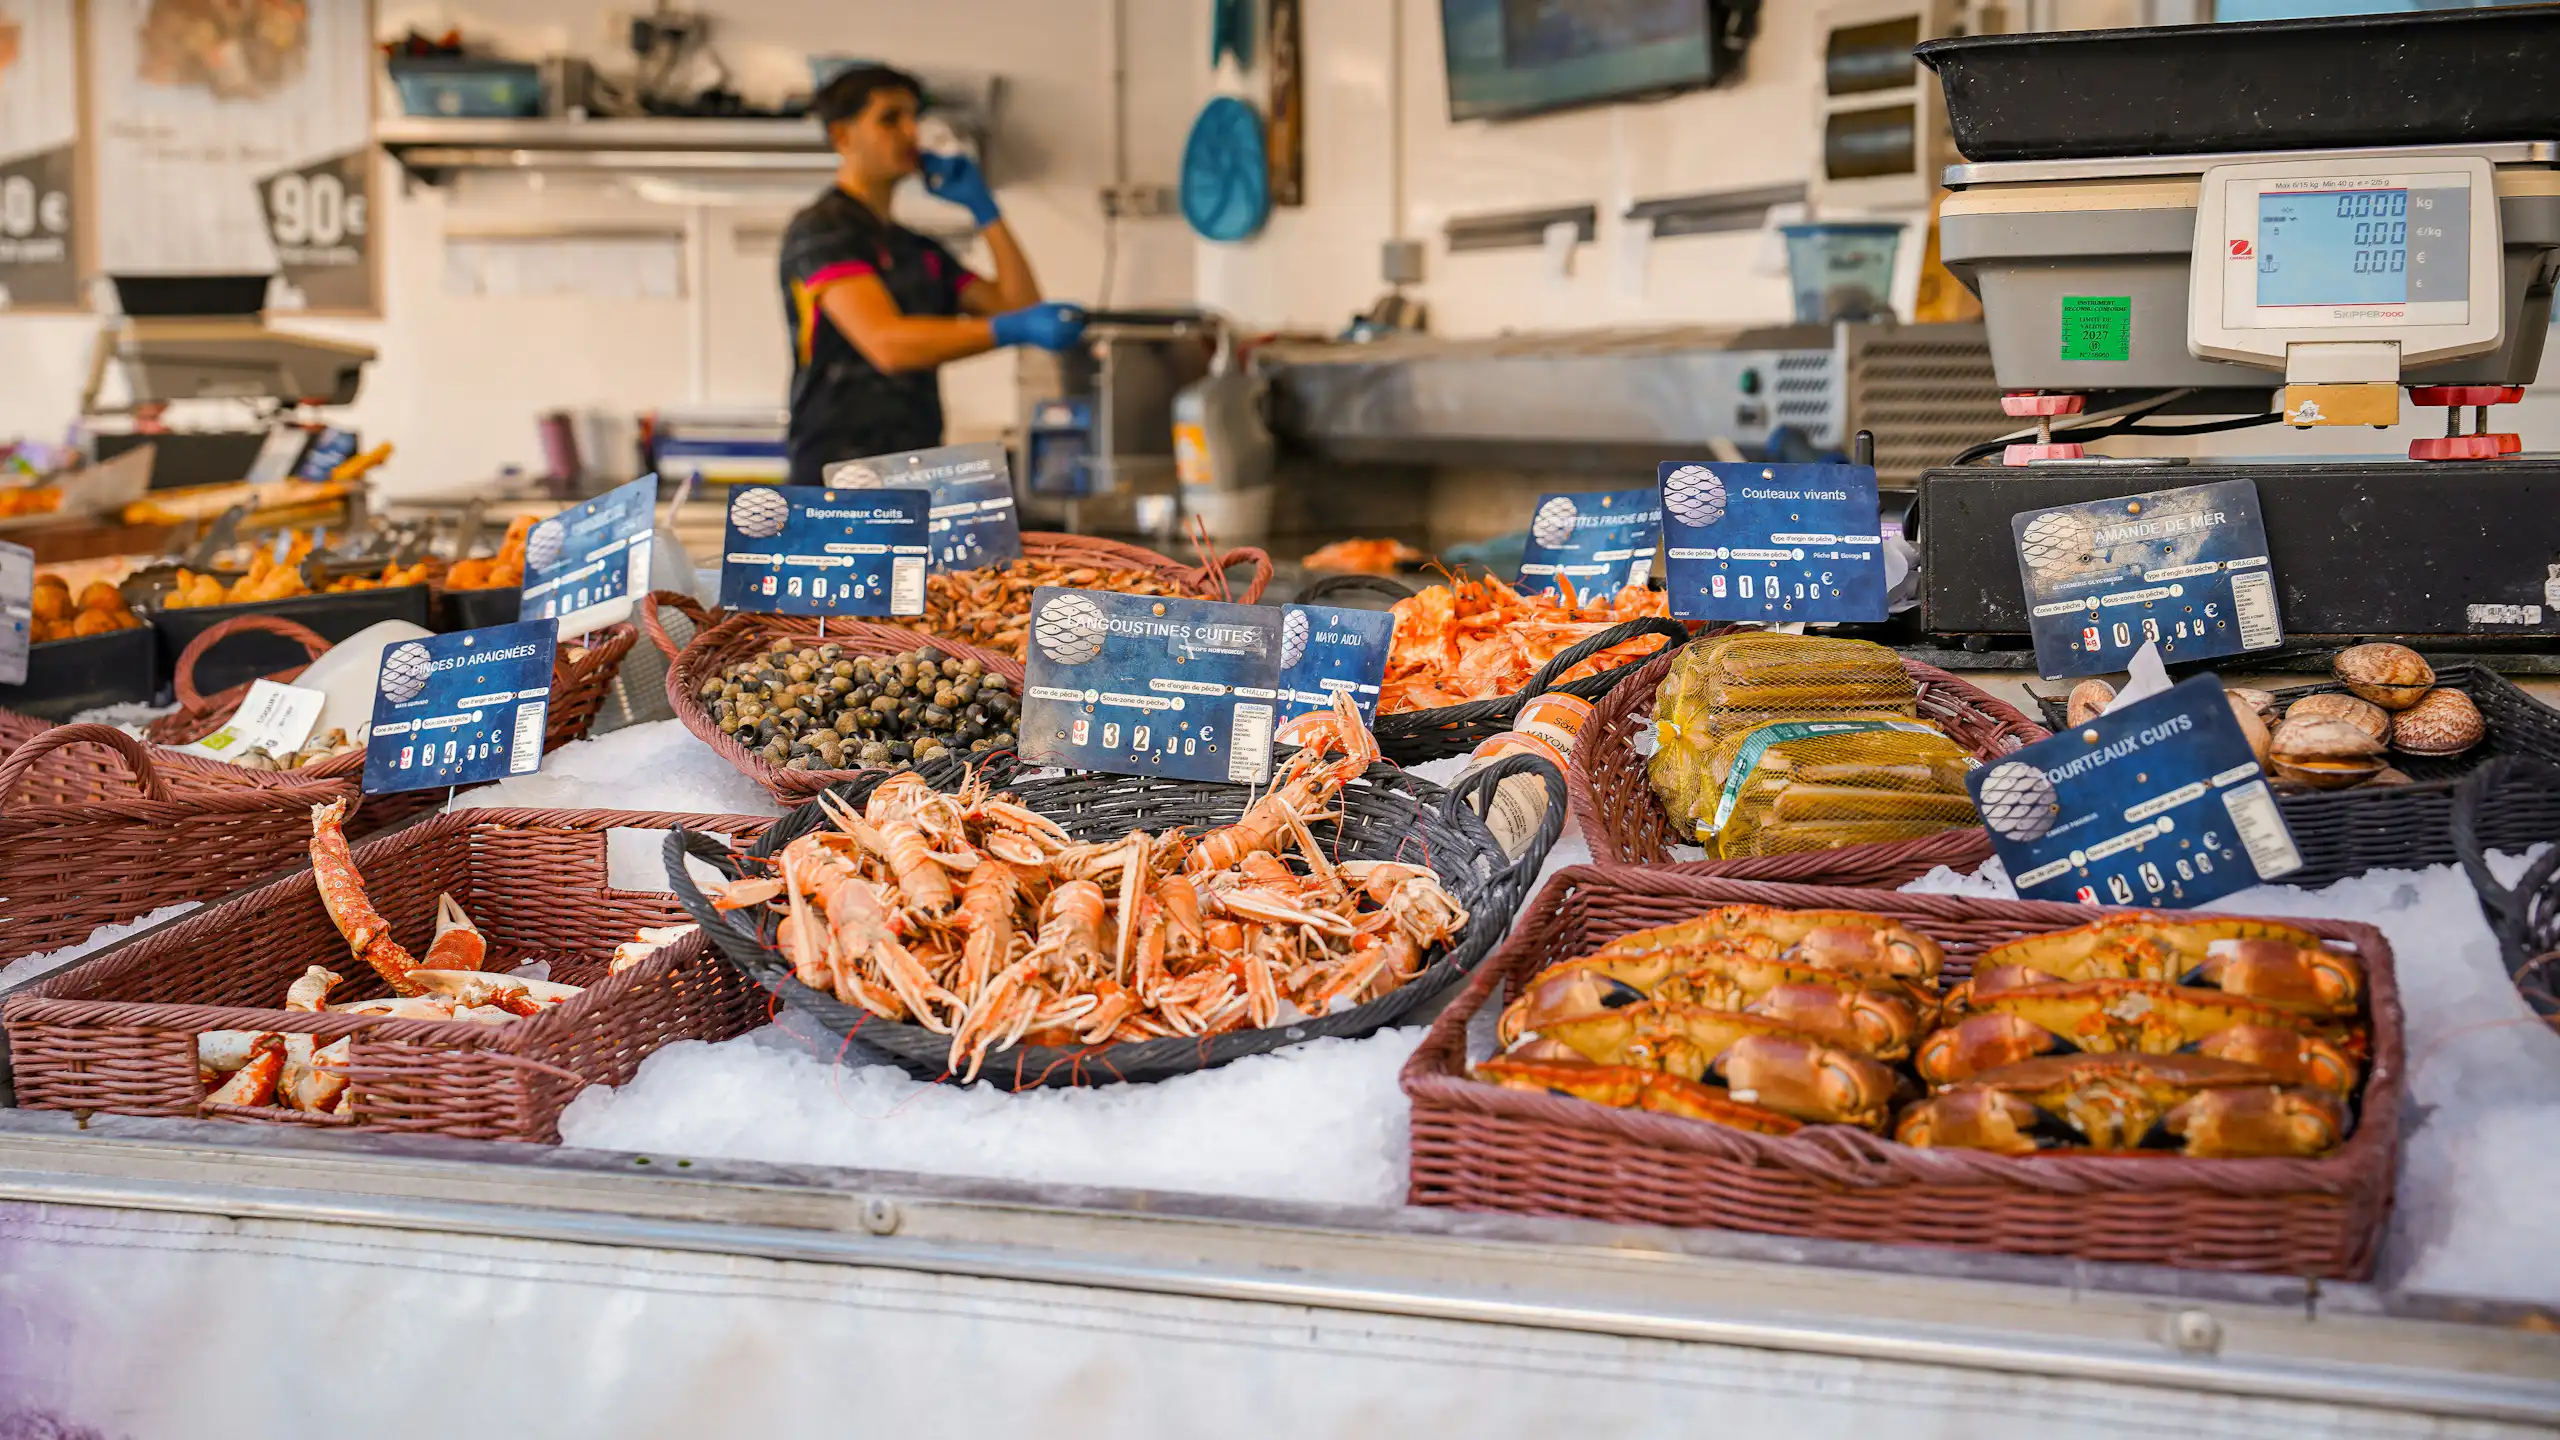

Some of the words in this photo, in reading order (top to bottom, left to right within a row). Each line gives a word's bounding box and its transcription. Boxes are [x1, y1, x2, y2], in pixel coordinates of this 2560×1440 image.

[2322, 180, 2336, 188] Min
[2337, 180, 2347, 188] 40
[2336, 193, 2407, 220] 0,000
[2416, 196, 2433, 210] kg
[2354, 221, 2406, 247] 0,00
[2416, 227, 2442, 238] €/kg
[2353, 249, 2406, 275] 0,00
[2416, 252, 2425, 264] €
[2082, 330, 2109, 340] 2027
[1741, 487, 1800, 500] Couteaux
[1803, 488, 1847, 501] vivants
[806, 507, 871, 520] Bigorneaux
[872, 508, 904, 519] Cuits
[2095, 522, 2162, 544] AMANDE
[2164, 518, 2189, 533] DE
[2190, 512, 2227, 529] MER
[2146, 572, 2160, 581] Type
[2160, 568, 2182, 579] d'engin
[2194, 564, 2214, 575] pêche
[2232, 558, 2261, 568] DRAGUE
[1820, 571, 1833, 586] €
[2103, 594, 2132, 604] Sous-zone
[2134, 592, 2144, 600] de
[2146, 588, 2165, 599] pêche
[2036, 606, 2053, 614] Zone
[2053, 604, 2062, 612] de
[2062, 602, 2082, 613] pêche
[2086, 637, 2098, 647] kg
[2204, 602, 2219, 618] €
[1195, 627, 1253, 644] CUITES
[1315, 631, 1338, 644] MAYO
[1340, 634, 1362, 646] AIOLI
[412, 658, 454, 675] PINCES
[456, 656, 466, 668] D
[467, 644, 536, 666] ARAIGNÉES
[1208, 648, 1246, 656] NORVEGICUS
[1059, 690, 1079, 700] pêche
[1152, 680, 1166, 688] Type
[1167, 682, 1190, 690] d'engin
[1200, 684, 1220, 693] pêche
[1242, 688, 1270, 697] CHALUT
[494, 694, 509, 702] pêche
[1102, 694, 1136, 704] Sous-zone
[1146, 698, 1166, 708] pêche
[454, 716, 468, 724] pêche
[394, 724, 408, 732] pêche
[1074, 731, 1086, 741] kg
[1199, 726, 1214, 742] €
[490, 729, 502, 744] €
[2039, 735, 2140, 786] TOURTEAUX
[2142, 713, 2193, 747] CUITS
[2202, 830, 2222, 851] €
